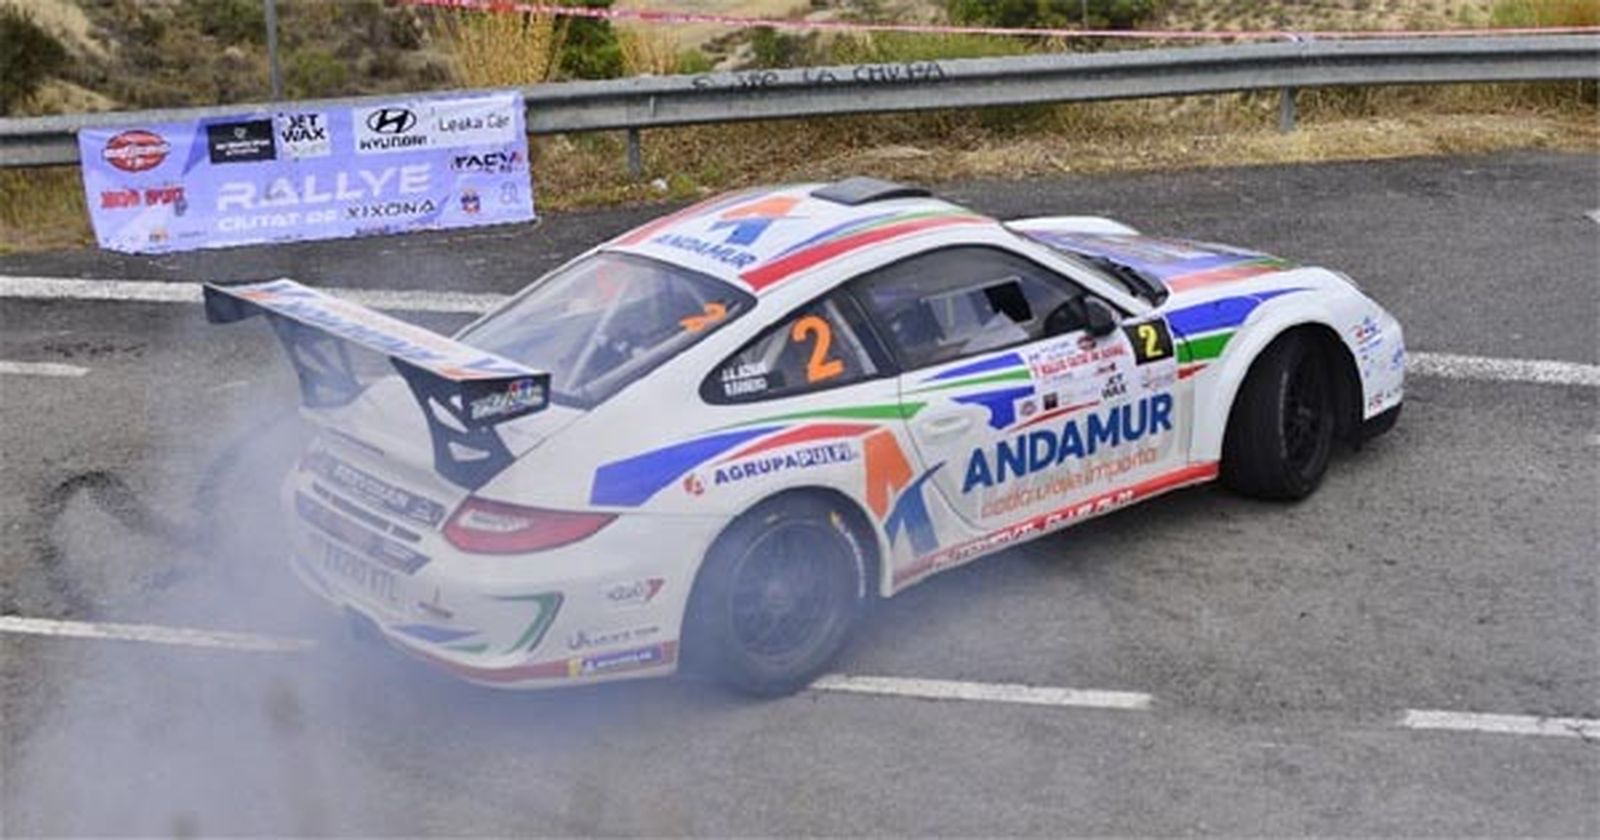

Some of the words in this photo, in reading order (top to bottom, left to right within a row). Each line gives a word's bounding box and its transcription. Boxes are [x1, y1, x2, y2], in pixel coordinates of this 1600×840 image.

[282, 127, 326, 144] WAX
[288, 113, 319, 128] JET
[487, 113, 511, 127] Car
[360, 135, 427, 150] HYUNDAI
[217, 163, 432, 212] RALLYE
[217, 212, 302, 232] CIUTAT
[346, 199, 436, 219] XIXONA
[791, 315, 845, 384] 2
[1137, 324, 1163, 358] 2
[962, 393, 1174, 494] ANDAMUR
